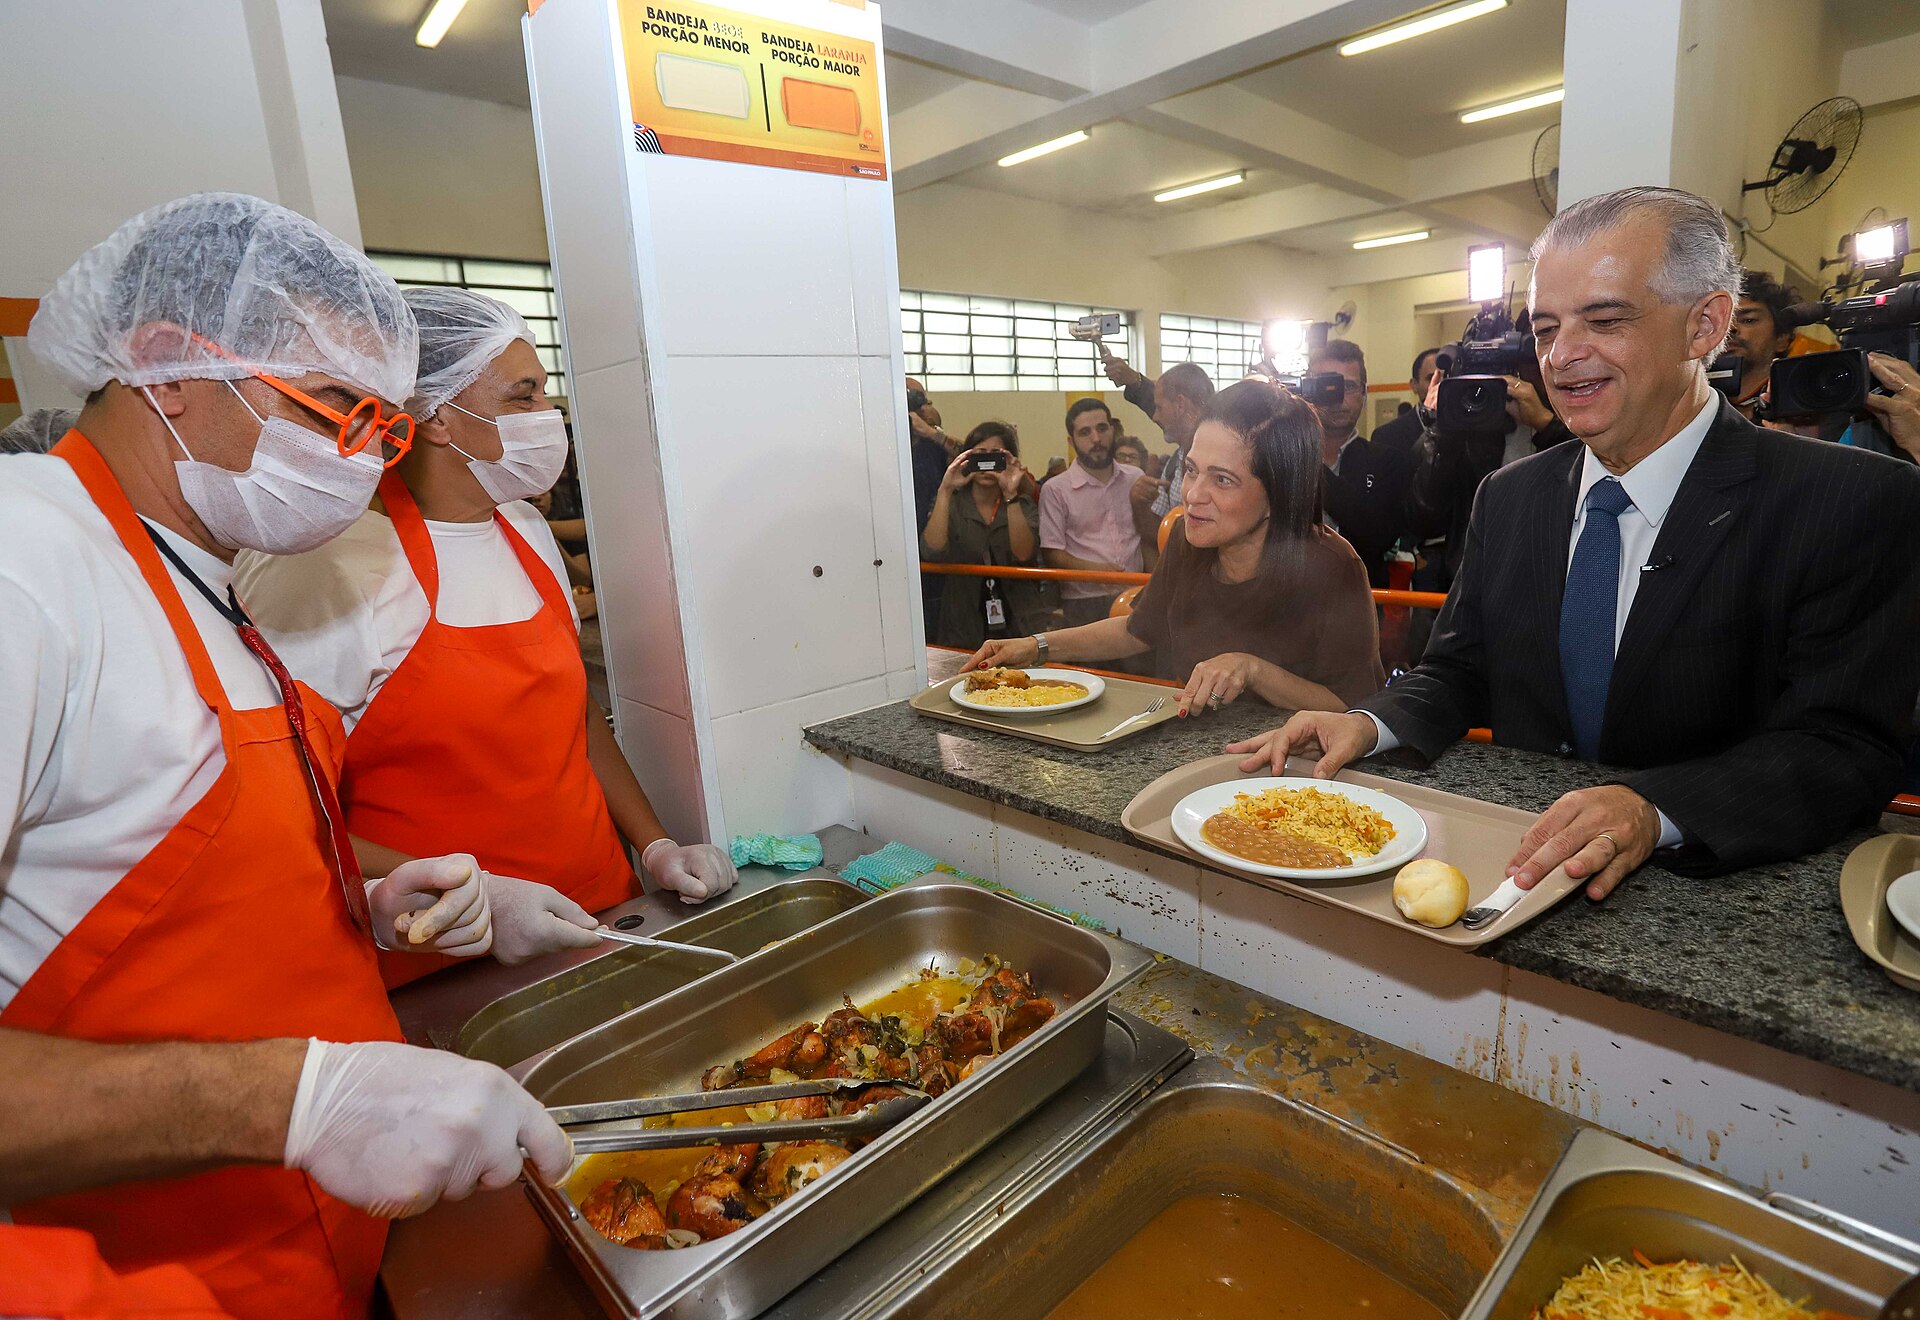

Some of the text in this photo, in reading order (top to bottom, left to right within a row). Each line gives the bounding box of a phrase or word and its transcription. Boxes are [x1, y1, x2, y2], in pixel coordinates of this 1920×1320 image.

[646, 6, 708, 31] BANDEJA
[642, 21, 750, 55] PORÇÃO MENOR
[761, 32, 867, 65] BANDEJA LARANJA
[771, 48, 861, 77] PORÇÃO MAIOR
